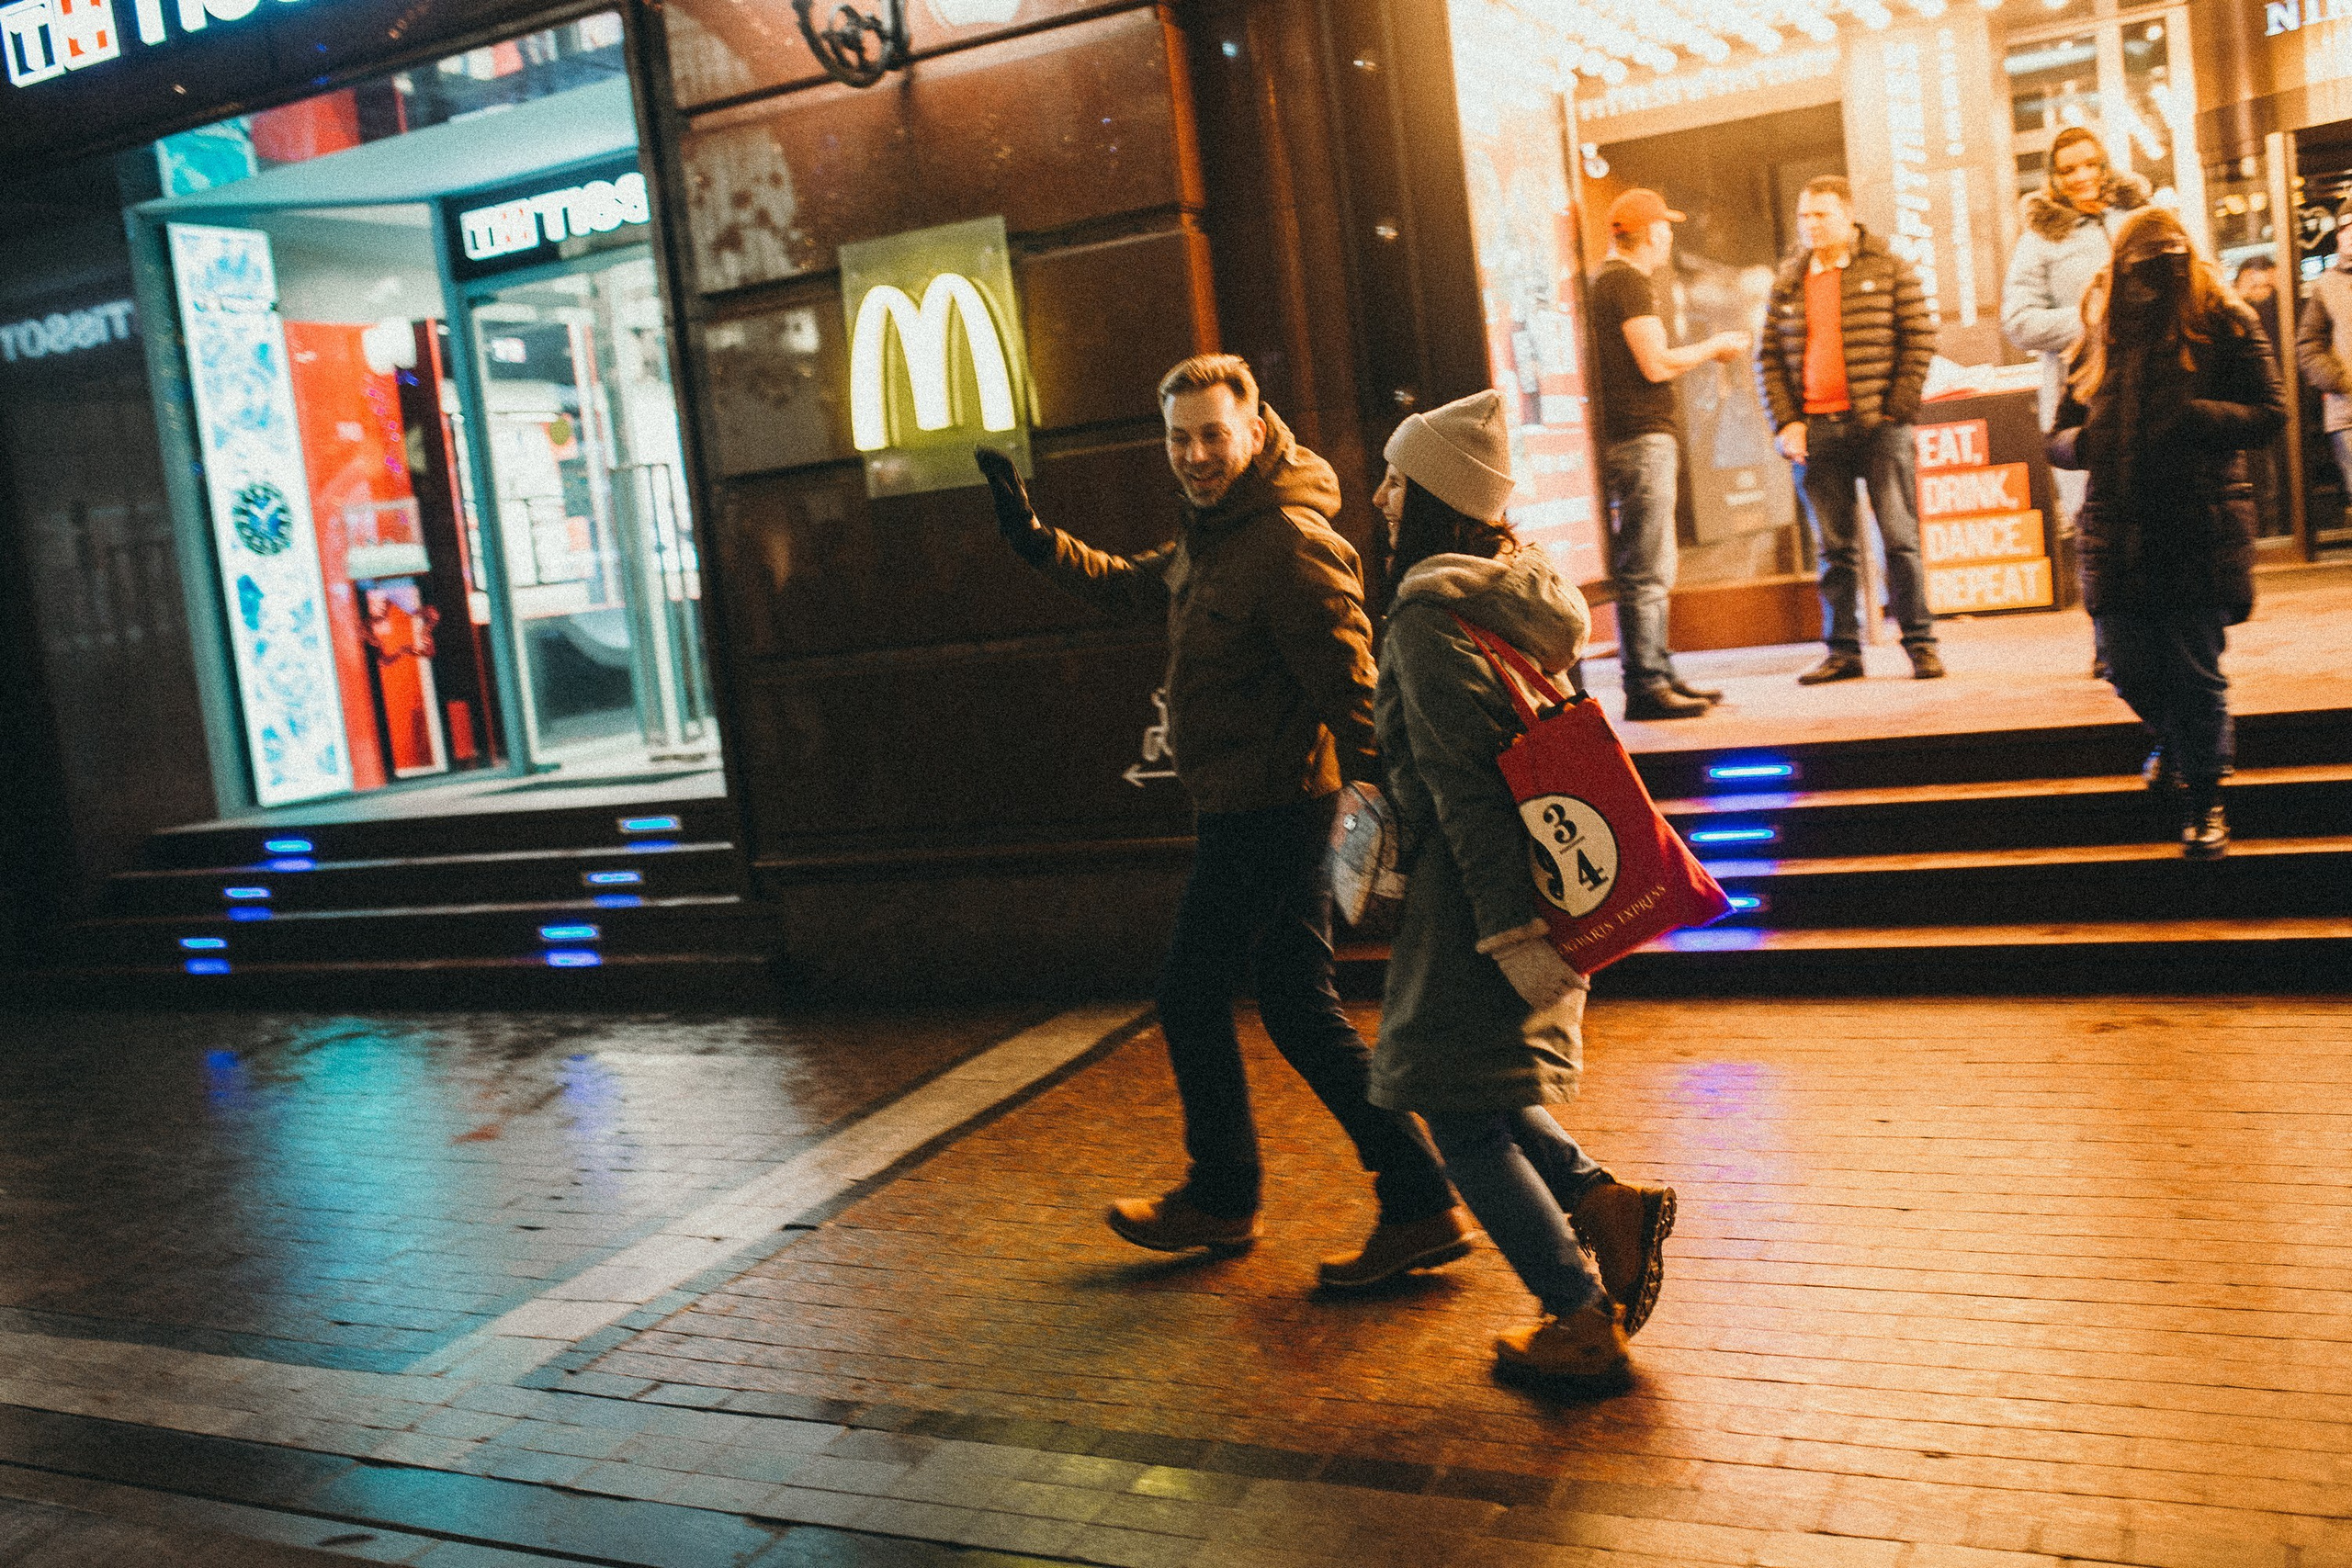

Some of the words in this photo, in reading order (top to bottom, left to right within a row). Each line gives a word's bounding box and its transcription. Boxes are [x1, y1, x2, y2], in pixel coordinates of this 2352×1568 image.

[1916, 424, 1983, 468] EAT.
[1921, 470, 2020, 514] DRINK.
[1929, 564, 2041, 608] REPEAT
[1556, 921, 1615, 955] OGWARTS
[1615, 883, 1667, 925] EXPRESS
